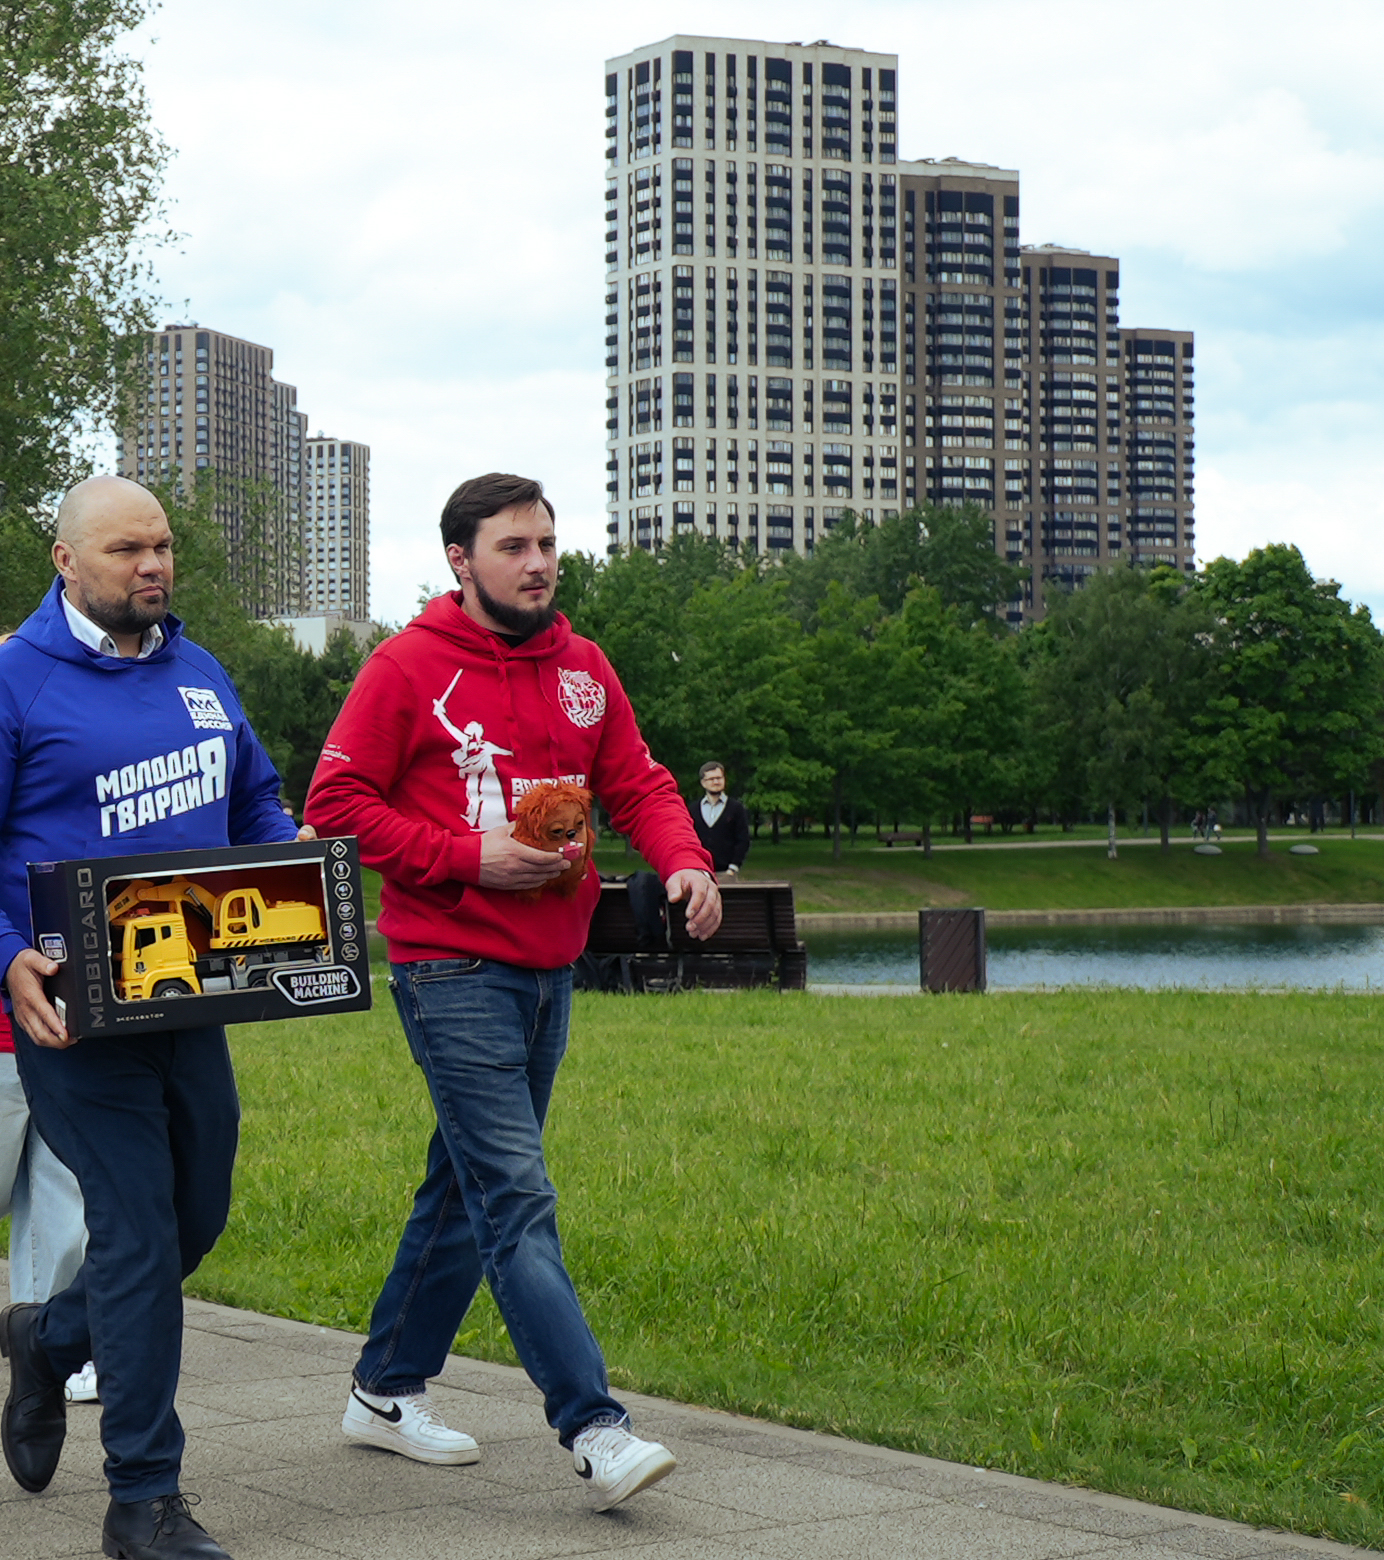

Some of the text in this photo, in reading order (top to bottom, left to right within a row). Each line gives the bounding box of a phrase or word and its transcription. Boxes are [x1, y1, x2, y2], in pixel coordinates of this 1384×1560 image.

[96, 736, 226, 803] МОЛОДАЯ
[77, 867, 106, 1028] MOBICARO
[290, 971, 349, 988] BUILDING
[294, 983, 349, 998] MACHINE
